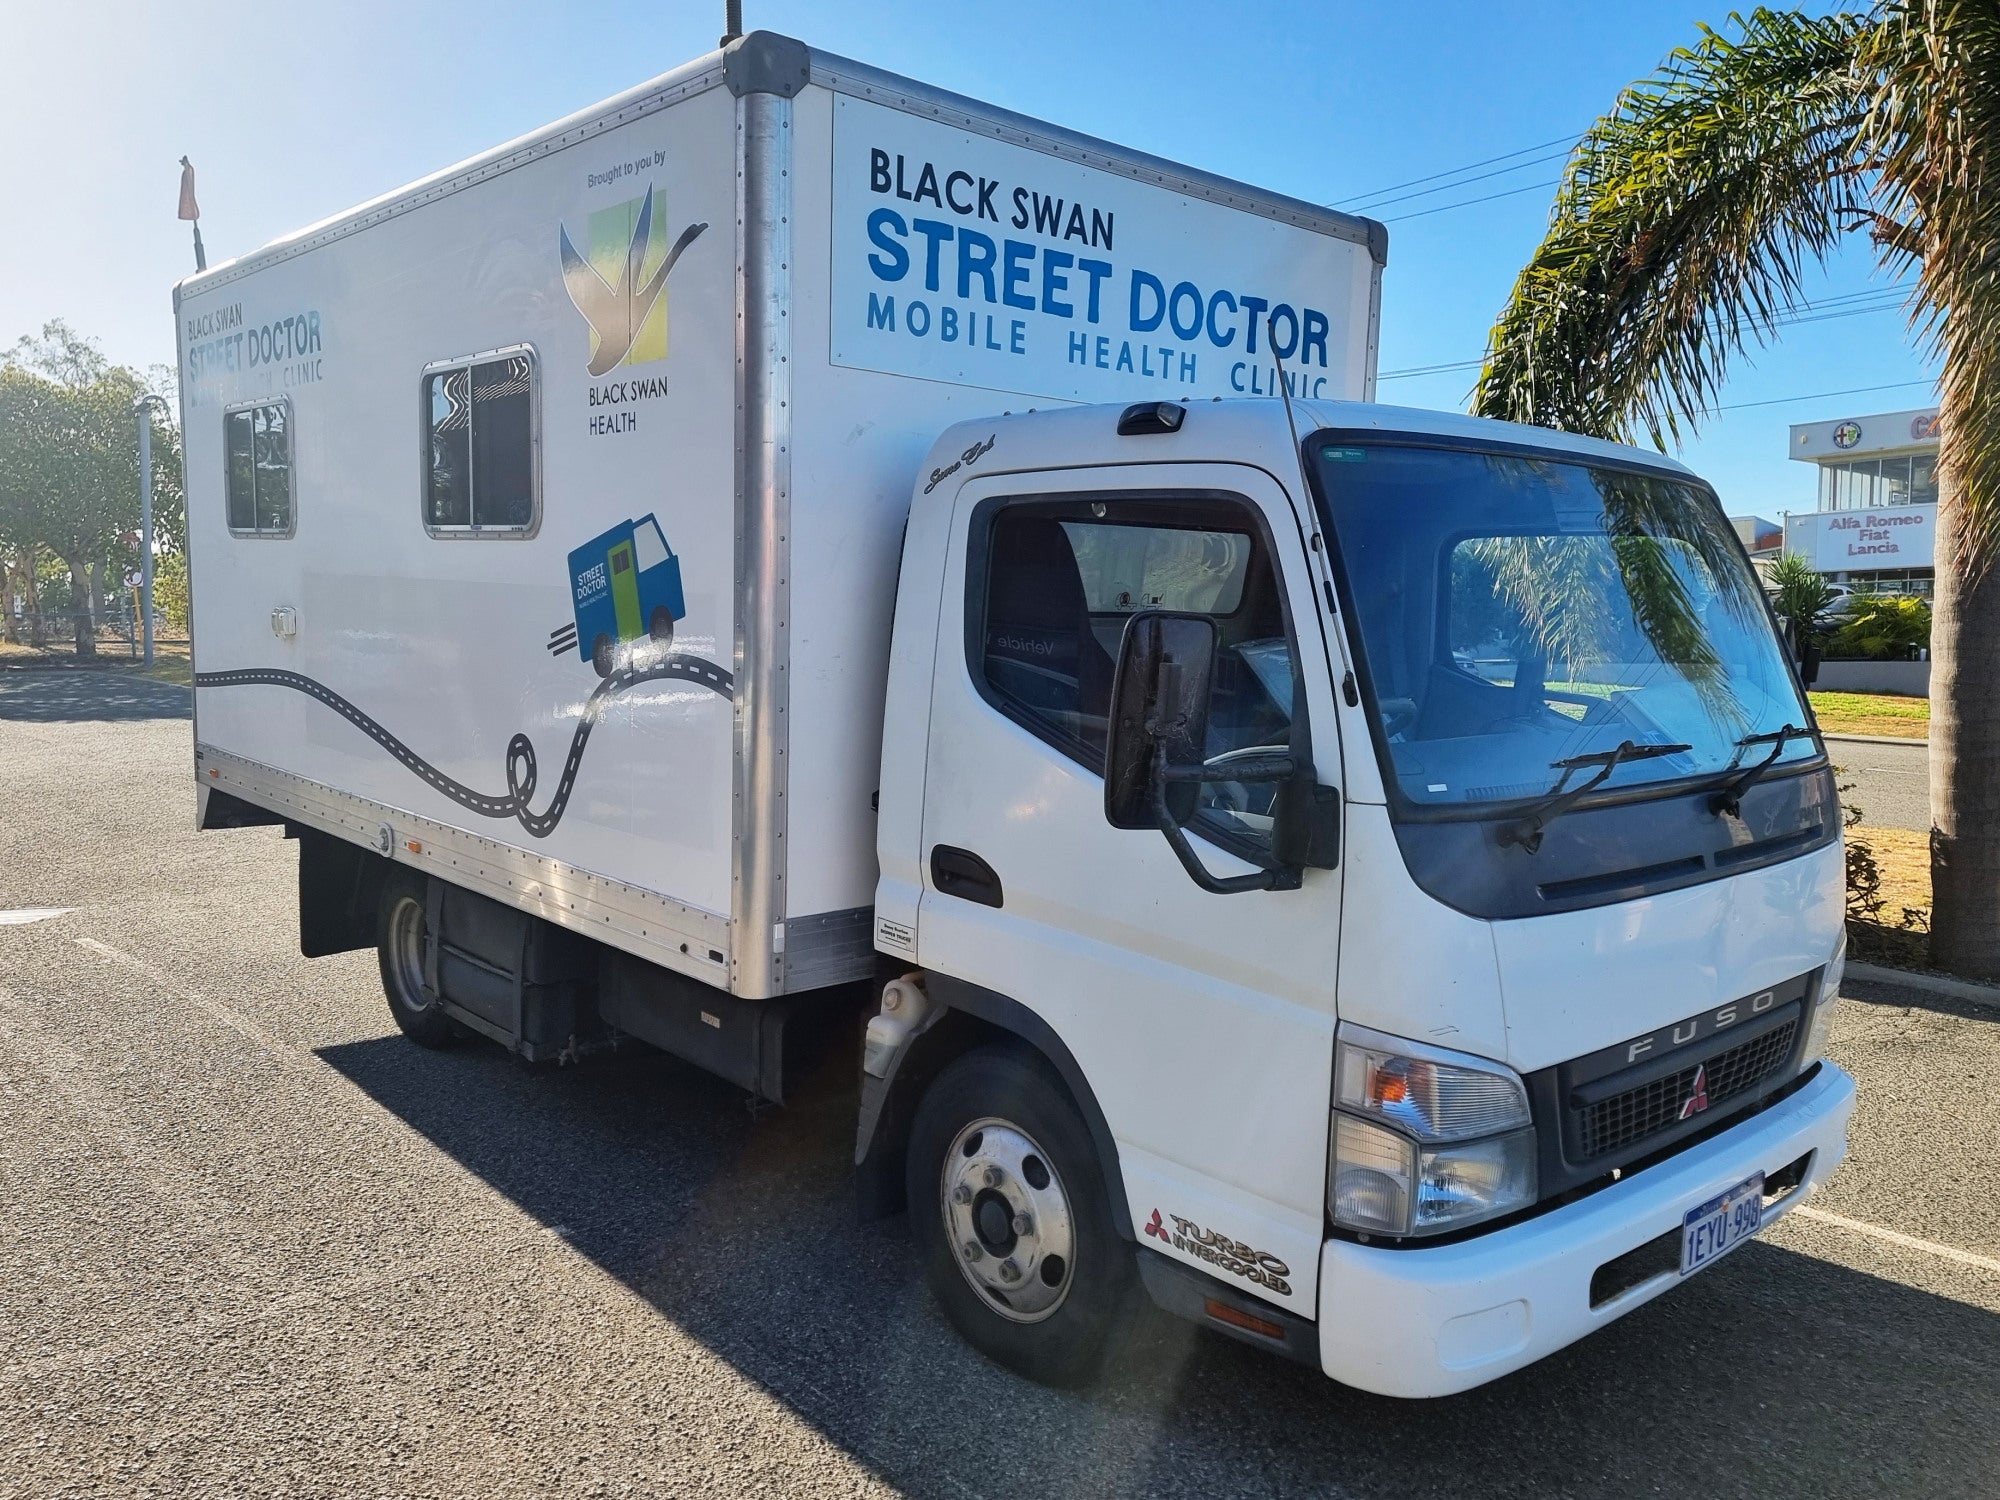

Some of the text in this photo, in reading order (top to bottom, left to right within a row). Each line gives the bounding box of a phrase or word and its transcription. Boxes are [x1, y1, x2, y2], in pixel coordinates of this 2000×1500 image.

[588, 150, 666, 189] Brought to you by
[871, 147, 1114, 251] BLACK SWAN
[867, 207, 1329, 367] STREET DOCTOR
[188, 302, 243, 341] BLACK SWAN
[189, 332, 243, 383] STREET
[248, 310, 322, 368] DOCTOR
[867, 292, 1328, 399] MOBILE HEALTH CLINIC
[283, 358, 323, 388] CLINIC
[589, 376, 668, 407] BLACK SWAN
[589, 411, 636, 436] HEALTH
[1828, 515, 1924, 531] Alfa Romeo
[1859, 529, 1890, 542] Fiat
[1848, 541, 1899, 556] Lancia
[577, 575, 607, 600] DOCTOR
[578, 562, 604, 586] STREET
[1628, 991, 1774, 1063] FUSO
[1169, 1213, 1291, 1277] TURBO
[1172, 1232, 1293, 1297] INTERCOOLED
